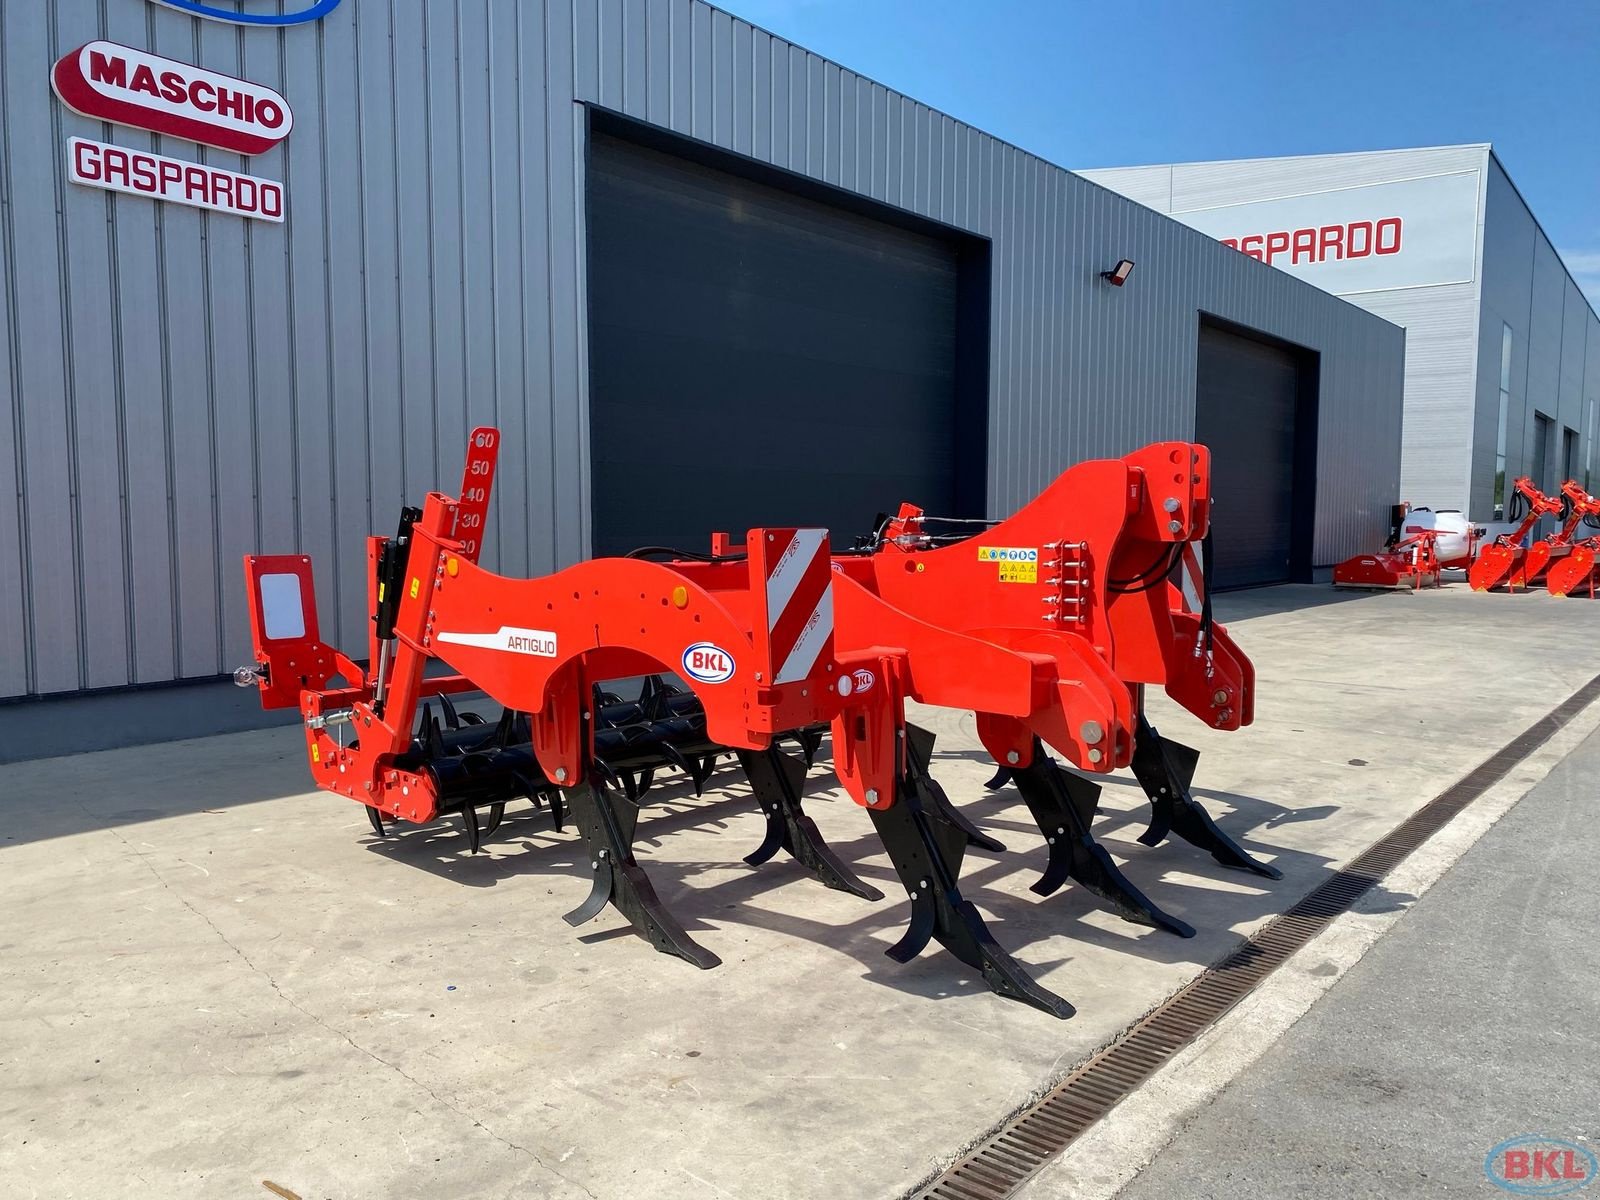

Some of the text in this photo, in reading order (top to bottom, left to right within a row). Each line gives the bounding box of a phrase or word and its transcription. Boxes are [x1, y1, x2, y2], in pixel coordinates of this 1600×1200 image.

[90, 51, 284, 129] MASCHIO
[75, 142, 281, 217] GASPARDO
[1220, 217, 1402, 266] SPARDO
[475, 433, 495, 448] 60
[471, 460, 490, 475] 50
[466, 487, 485, 502] 40
[461, 513, 480, 528] 30
[507, 635, 555, 655] ARTIGLIO
[692, 651, 728, 672] BKL
